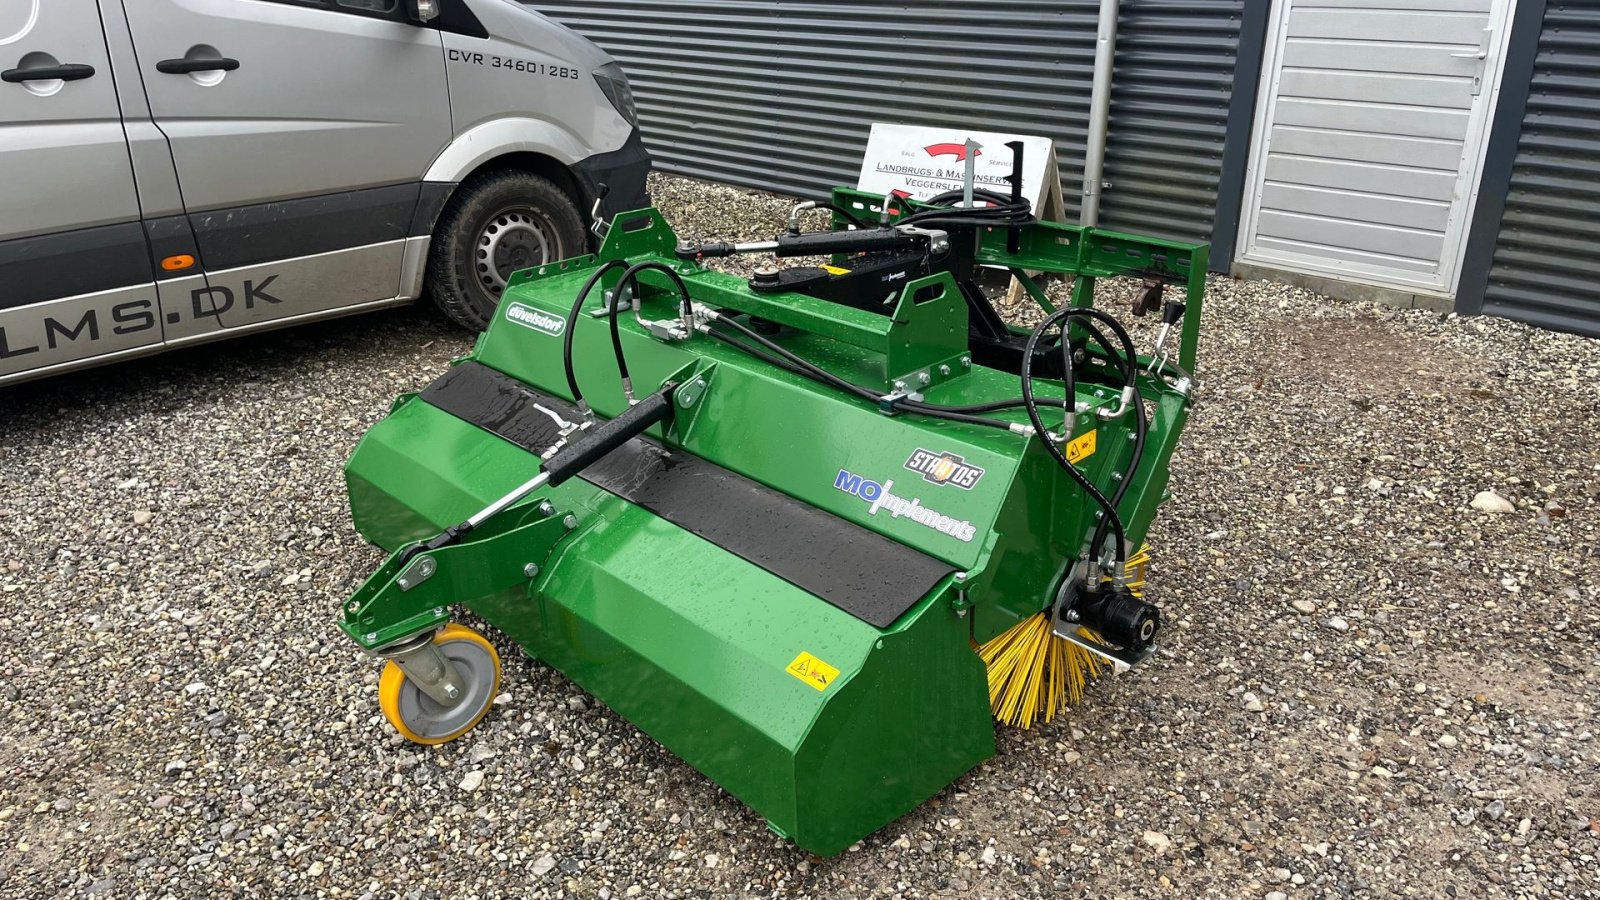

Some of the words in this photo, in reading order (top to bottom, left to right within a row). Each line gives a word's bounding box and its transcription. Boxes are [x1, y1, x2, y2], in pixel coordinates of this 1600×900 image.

[448, 49, 484, 66] CVR
[491, 56, 580, 80] 34601283
[935, 168, 944, 177] &
[508, 305, 563, 332] düvelsdorf
[909, 451, 979, 486] STRATOS
